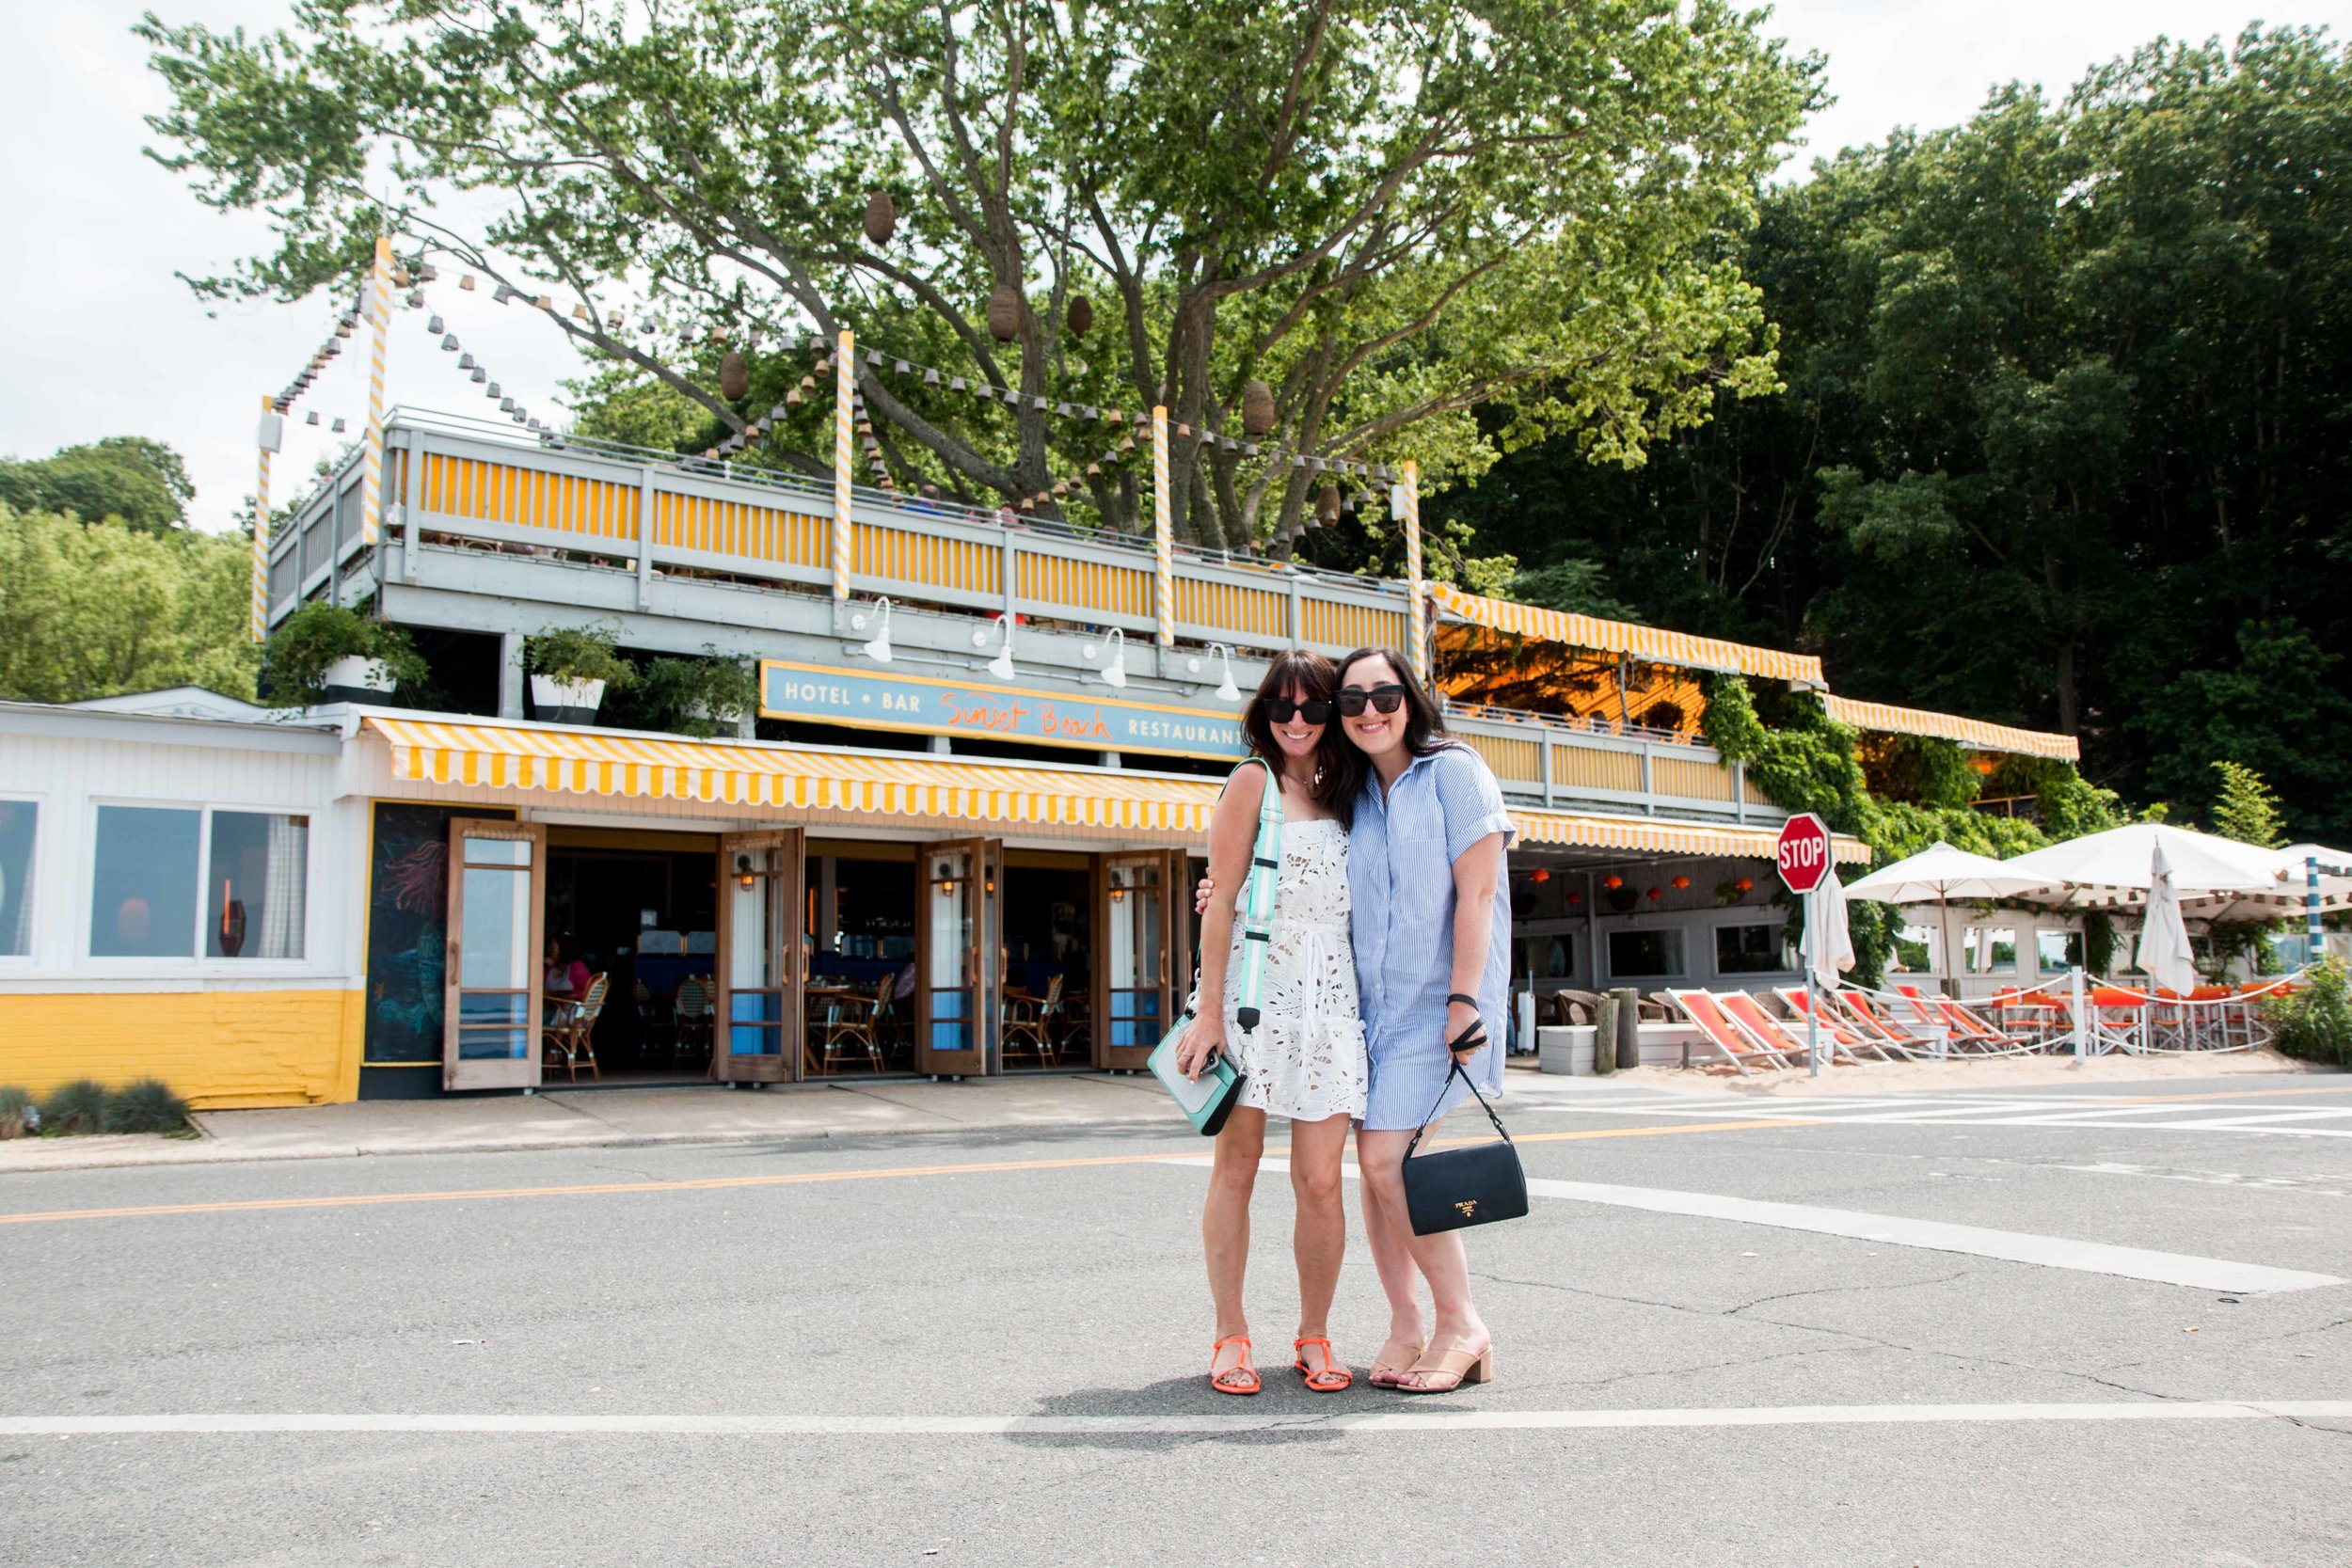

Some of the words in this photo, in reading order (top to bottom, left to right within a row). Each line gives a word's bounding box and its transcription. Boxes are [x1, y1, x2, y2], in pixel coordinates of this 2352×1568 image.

[785, 681, 850, 706] HOTEL
[882, 692, 920, 713] BAR
[940, 692, 1029, 732] Sunset
[1039, 703, 1113, 740] Beach
[1779, 835, 1824, 870] STOP
[1454, 1199, 1478, 1209] PRADA
